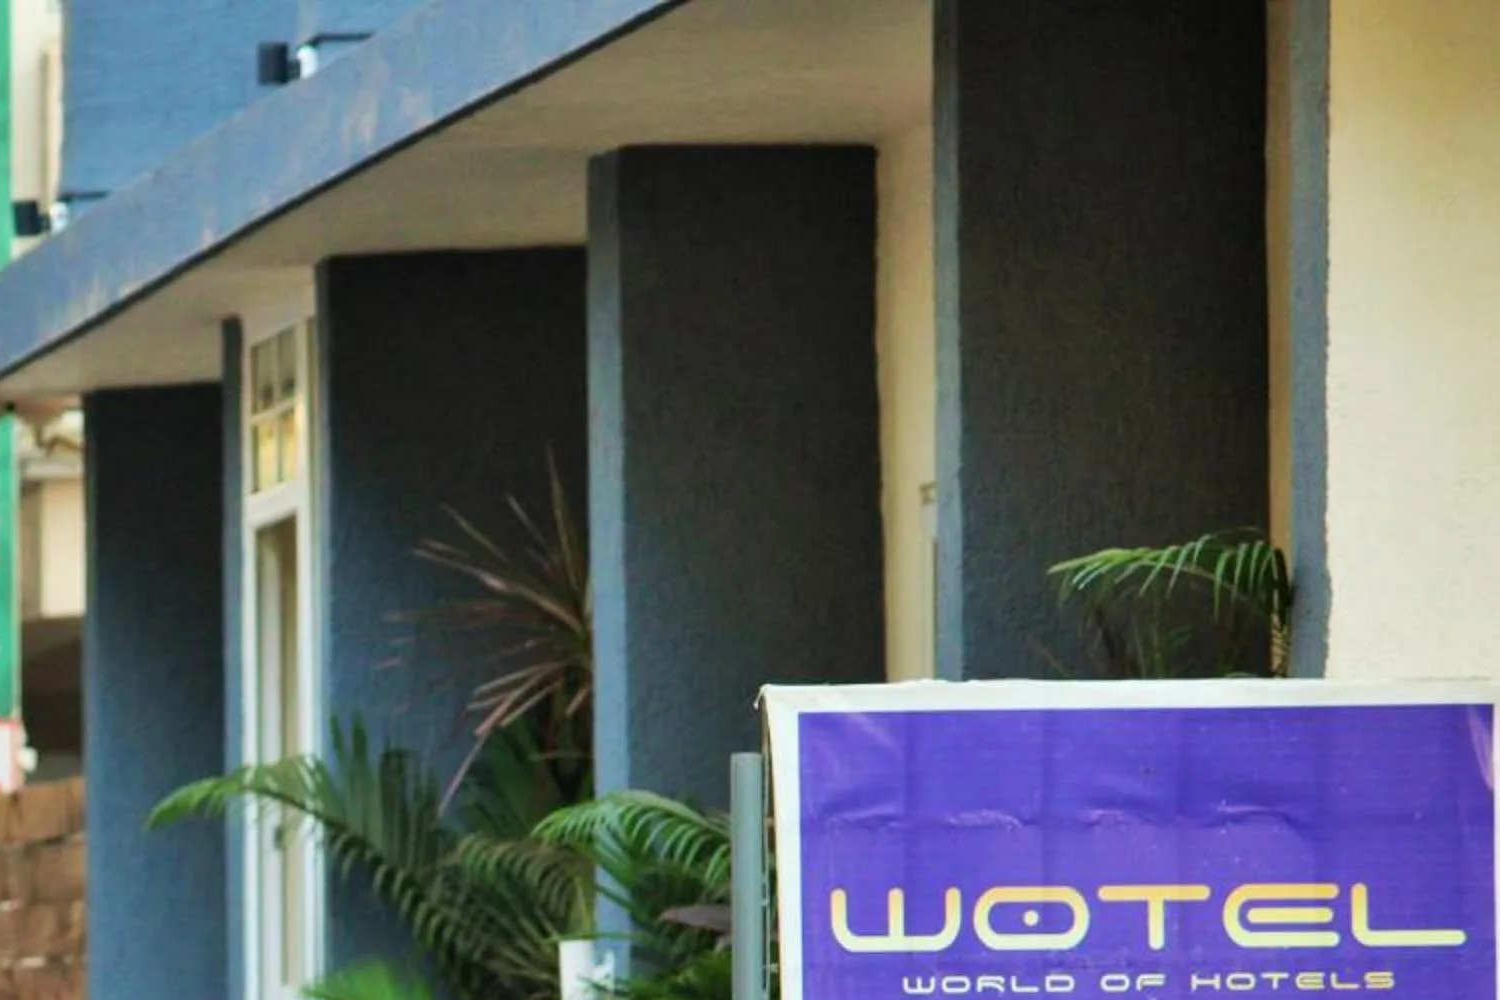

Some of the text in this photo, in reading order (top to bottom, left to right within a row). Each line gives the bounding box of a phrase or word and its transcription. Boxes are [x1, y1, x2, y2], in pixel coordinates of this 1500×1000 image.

[830, 882, 1467, 953] WOTEL
[902, 970, 1395, 995] WORLD OF HOTELS
